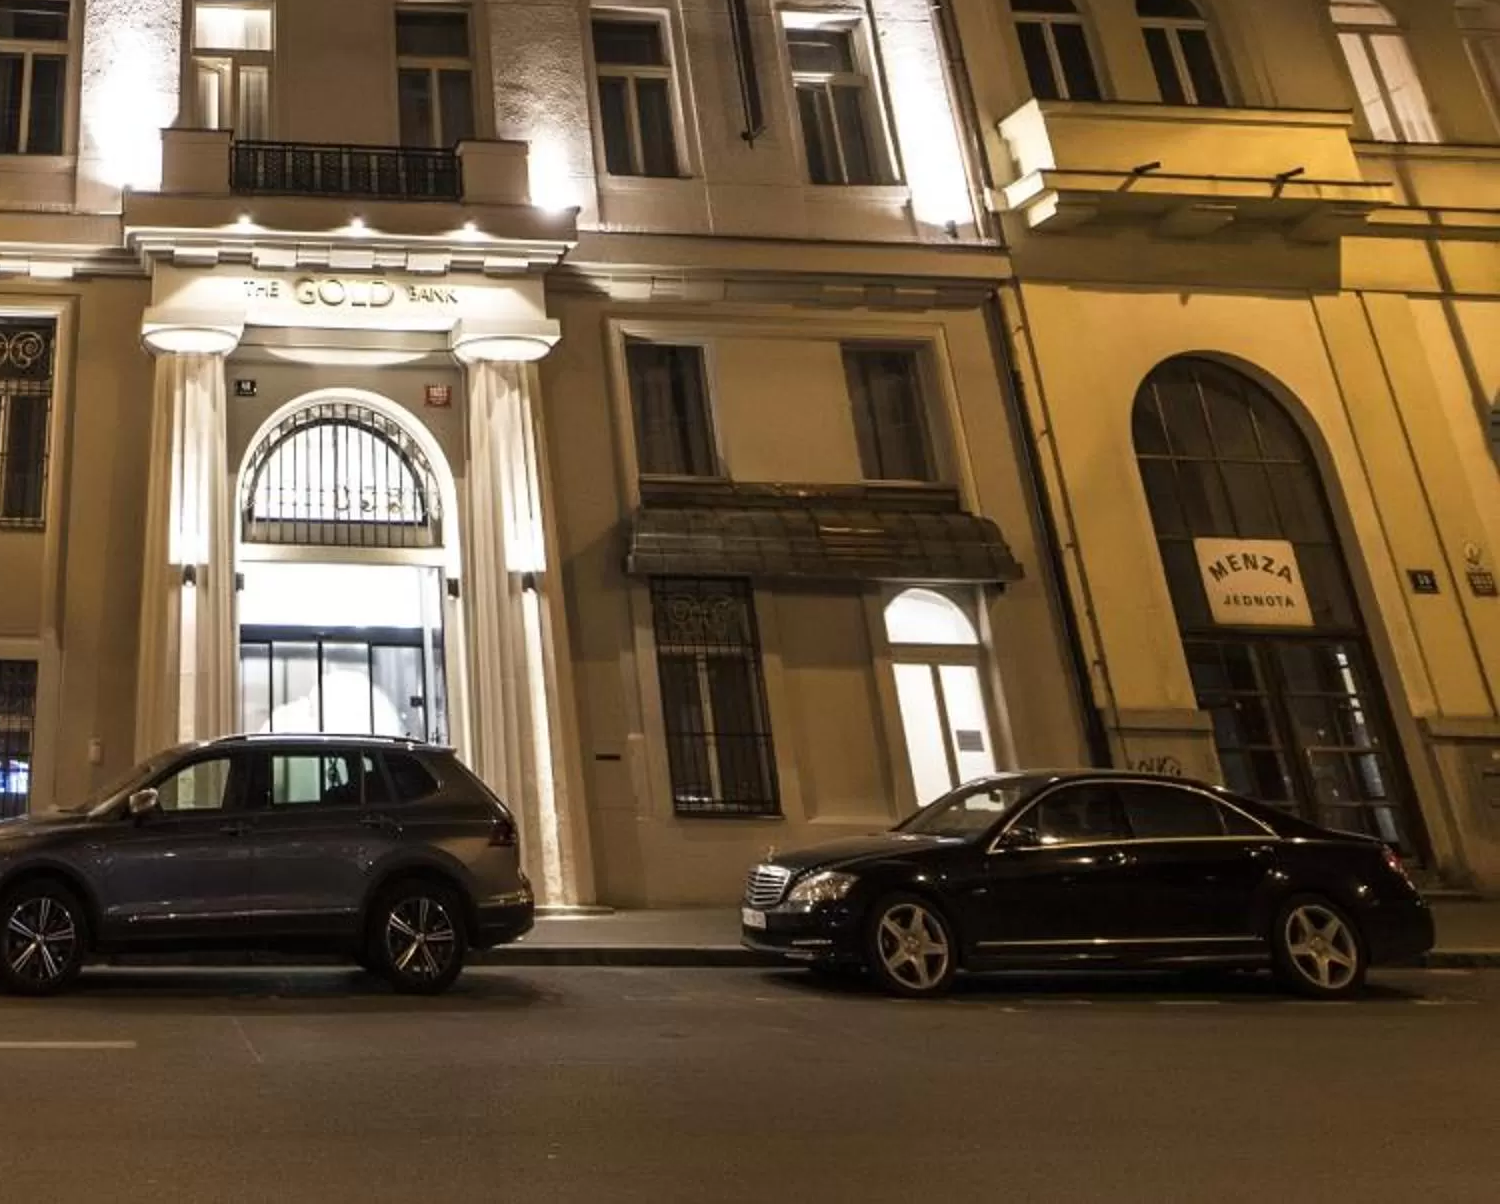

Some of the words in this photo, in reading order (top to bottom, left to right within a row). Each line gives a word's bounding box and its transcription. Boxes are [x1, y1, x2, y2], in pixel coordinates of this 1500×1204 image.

[243, 280, 279, 298] THE
[293, 276, 395, 308] GOLD
[406, 284, 459, 304] BANK
[1208, 553, 1292, 584] MENZA
[1223, 594, 1296, 608] JEDNOTA
